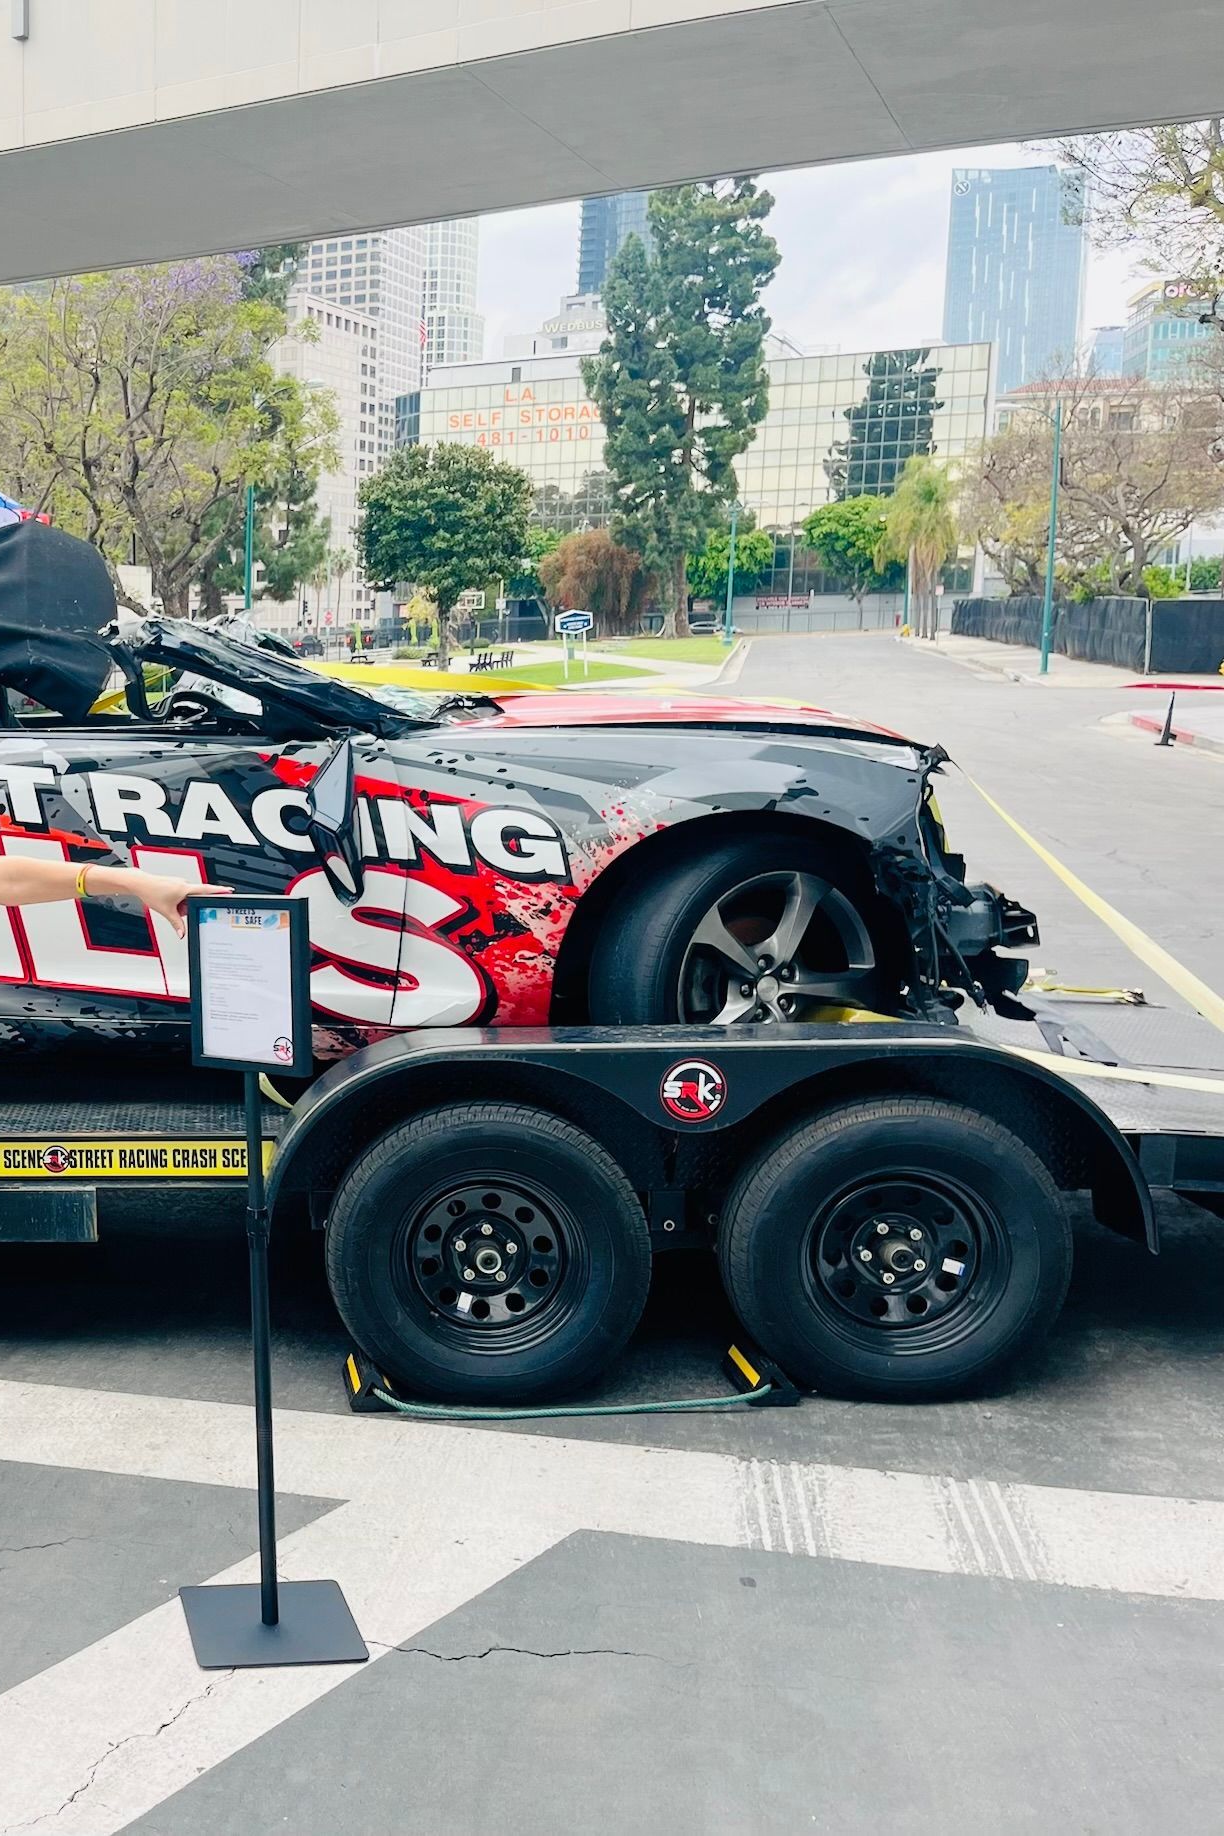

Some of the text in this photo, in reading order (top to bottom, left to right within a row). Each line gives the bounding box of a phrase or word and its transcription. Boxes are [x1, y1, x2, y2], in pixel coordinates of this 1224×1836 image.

[544, 319, 604, 334] WEDBUS
[449, 405, 601, 429] SELF STORA
[477, 425, 589, 447] 481-1010
[245, 916, 262, 925] SAFE
[3, 1149, 43, 1169] SCENE
[69, 1149, 114, 1169] STREET
[119, 1149, 169, 1169] RACING
[172, 1149, 217, 1168] CRASH
[222, 1148, 247, 1168] SCE
